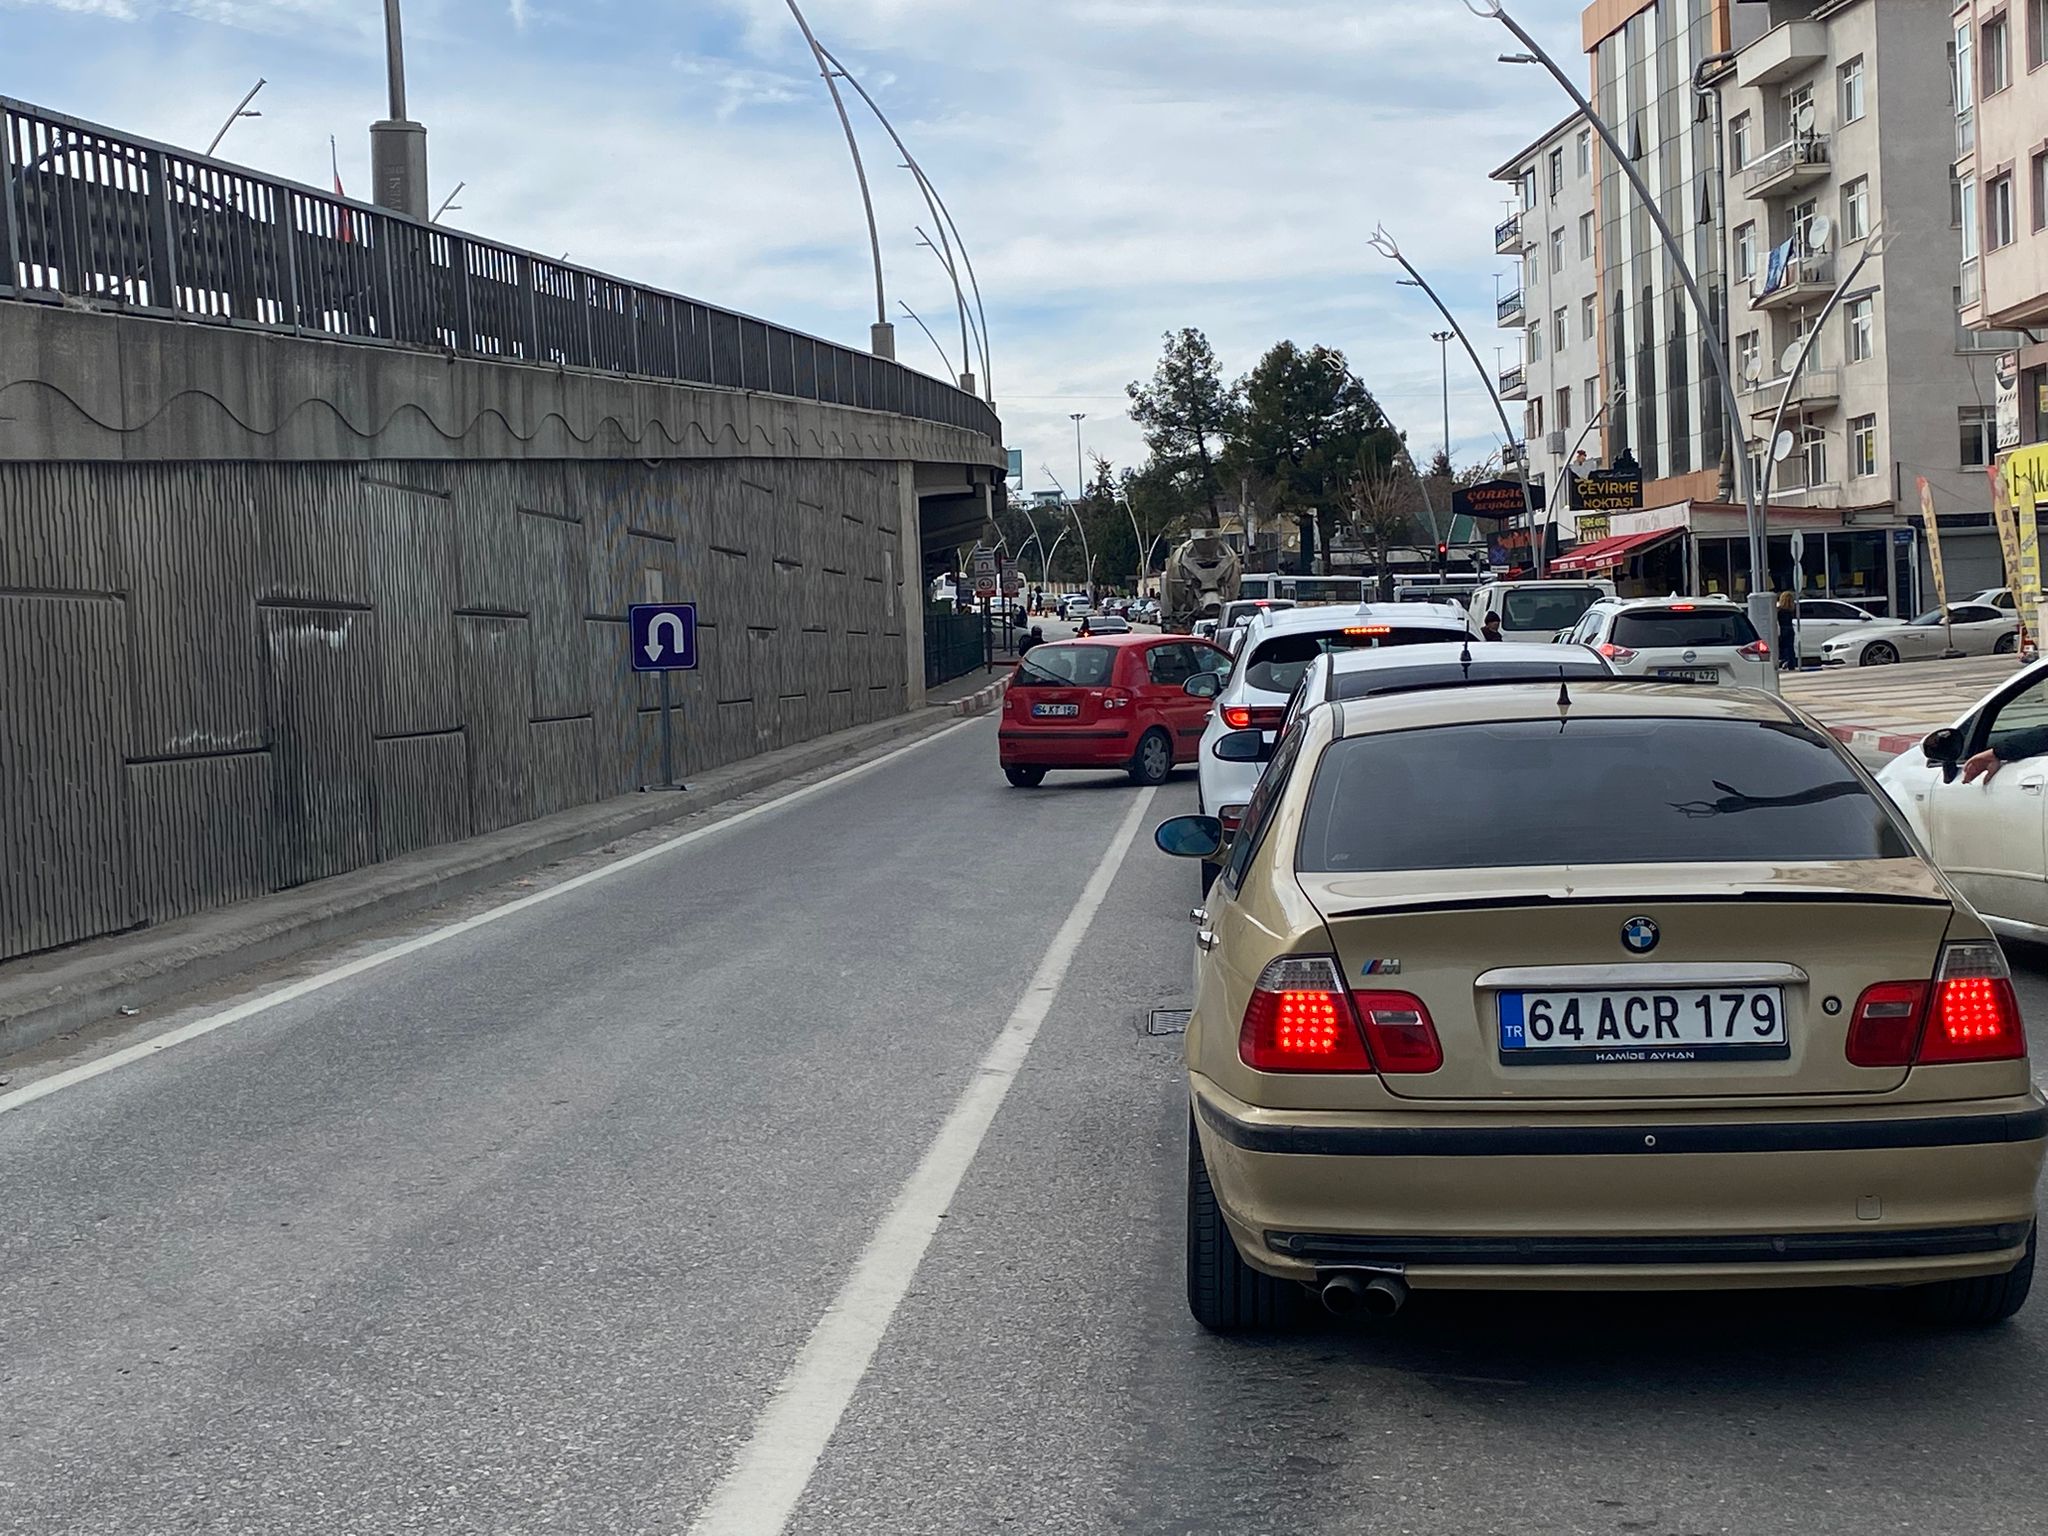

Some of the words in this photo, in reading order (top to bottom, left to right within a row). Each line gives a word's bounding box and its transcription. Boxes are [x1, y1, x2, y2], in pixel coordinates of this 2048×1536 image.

[1577, 480, 1639, 498] ÇEVİRME
[1467, 488, 1524, 503] ÇORBAC
[1583, 497, 1634, 509] NOKTASI
[1699, 671, 1716, 680] 472
[1624, 919, 1657, 931] BMW
[1529, 998, 1584, 1041] 64
[1596, 996, 1680, 1040] ACR
[1695, 993, 1776, 1038] 179
[1504, 1025, 1523, 1038] TR
[1650, 1051, 1695, 1060] AYHAN
